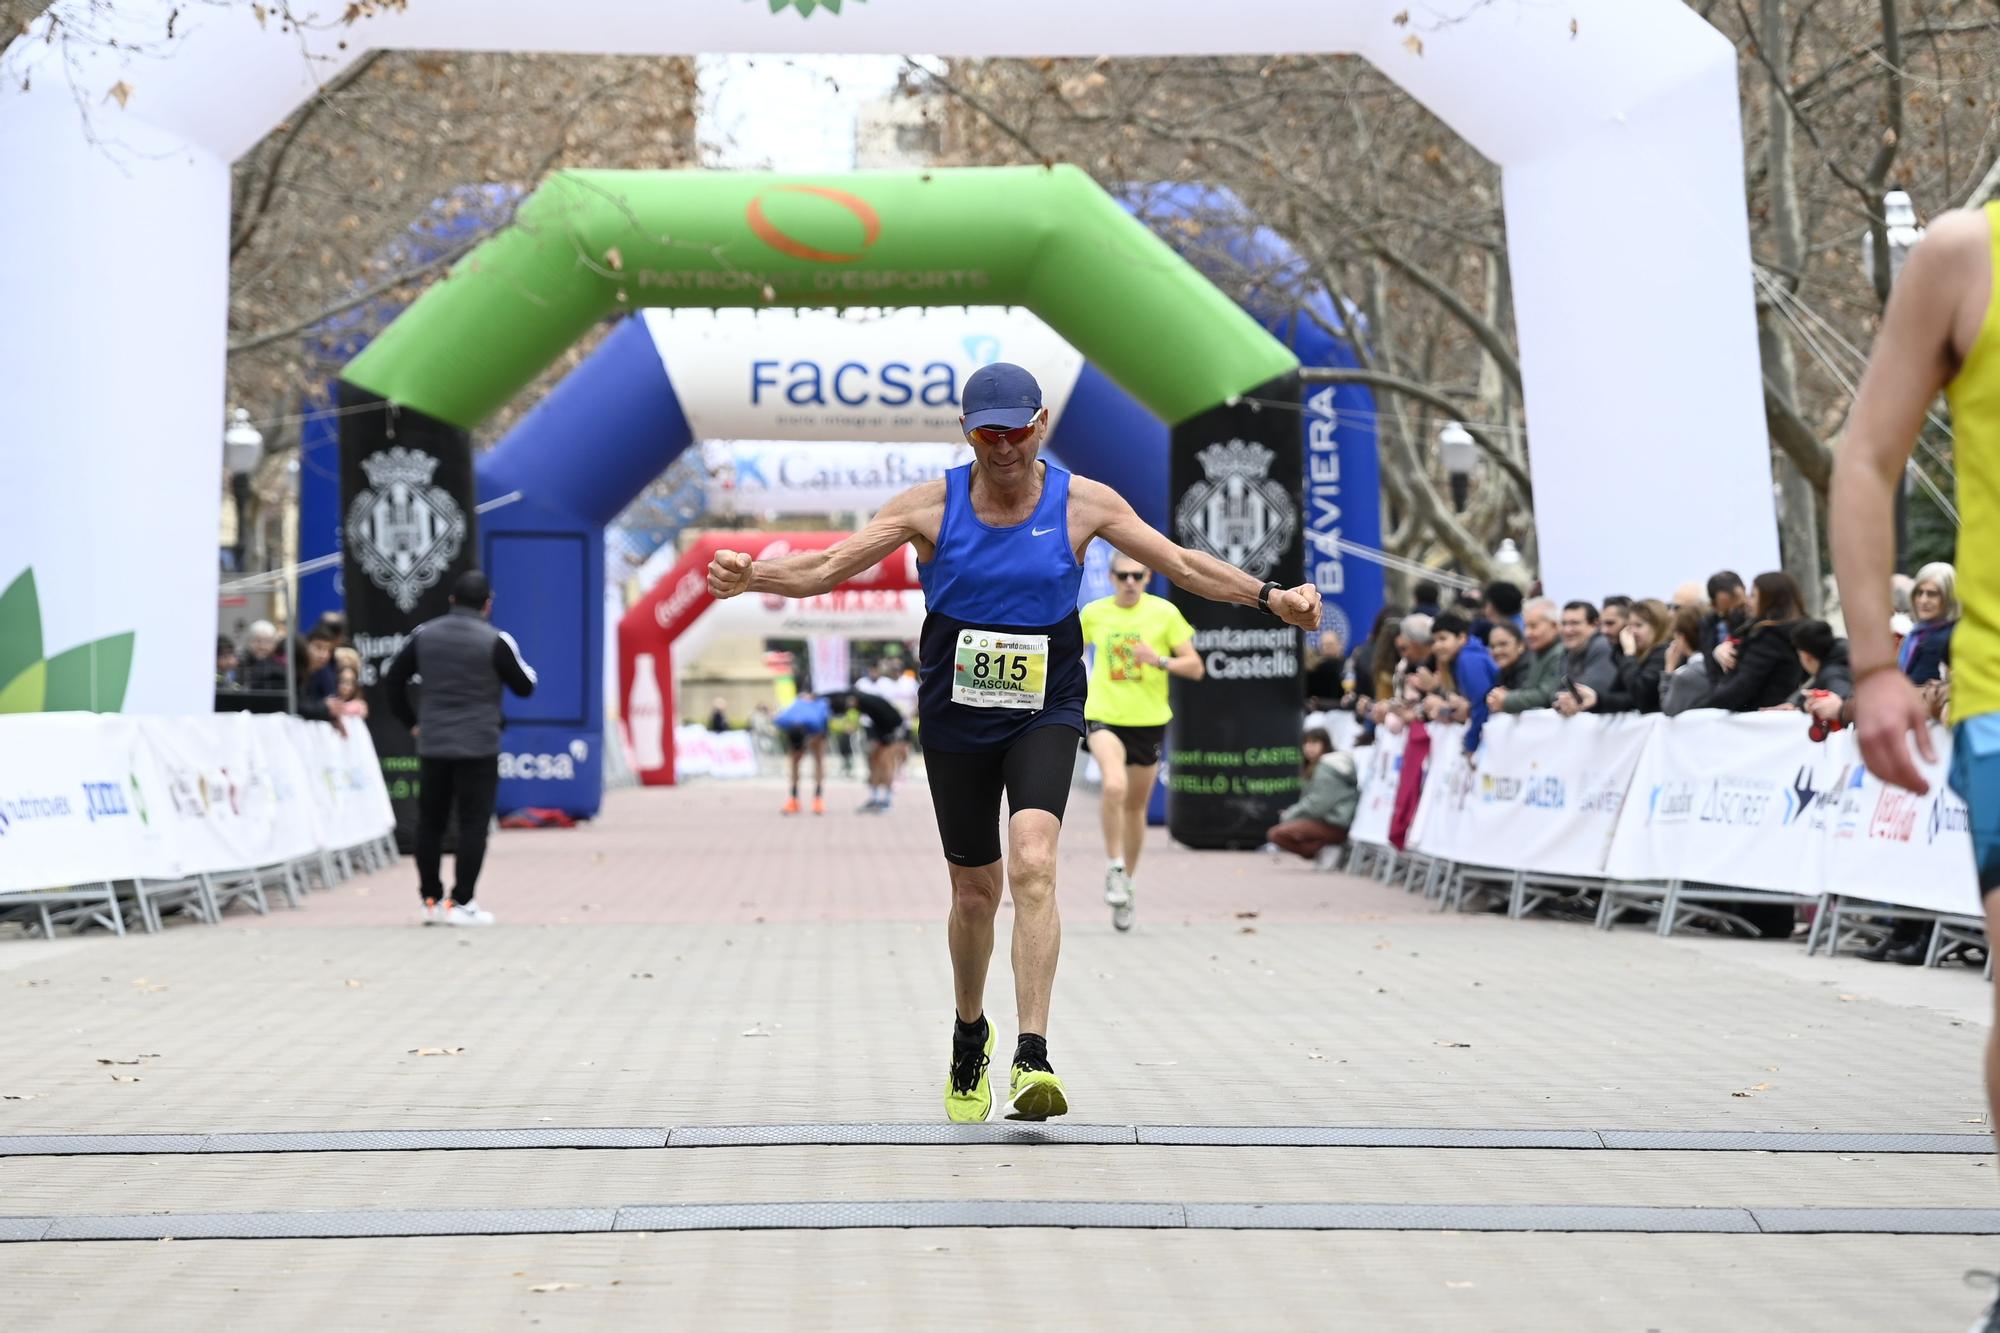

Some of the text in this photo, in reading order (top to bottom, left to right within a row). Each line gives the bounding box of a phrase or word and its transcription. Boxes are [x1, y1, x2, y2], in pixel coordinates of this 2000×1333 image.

[1308, 385, 1344, 594] BAVIERA
[973, 652, 1028, 681] 815
[973, 680, 1024, 691] PASCUAL
[498, 751, 576, 780] acsa
